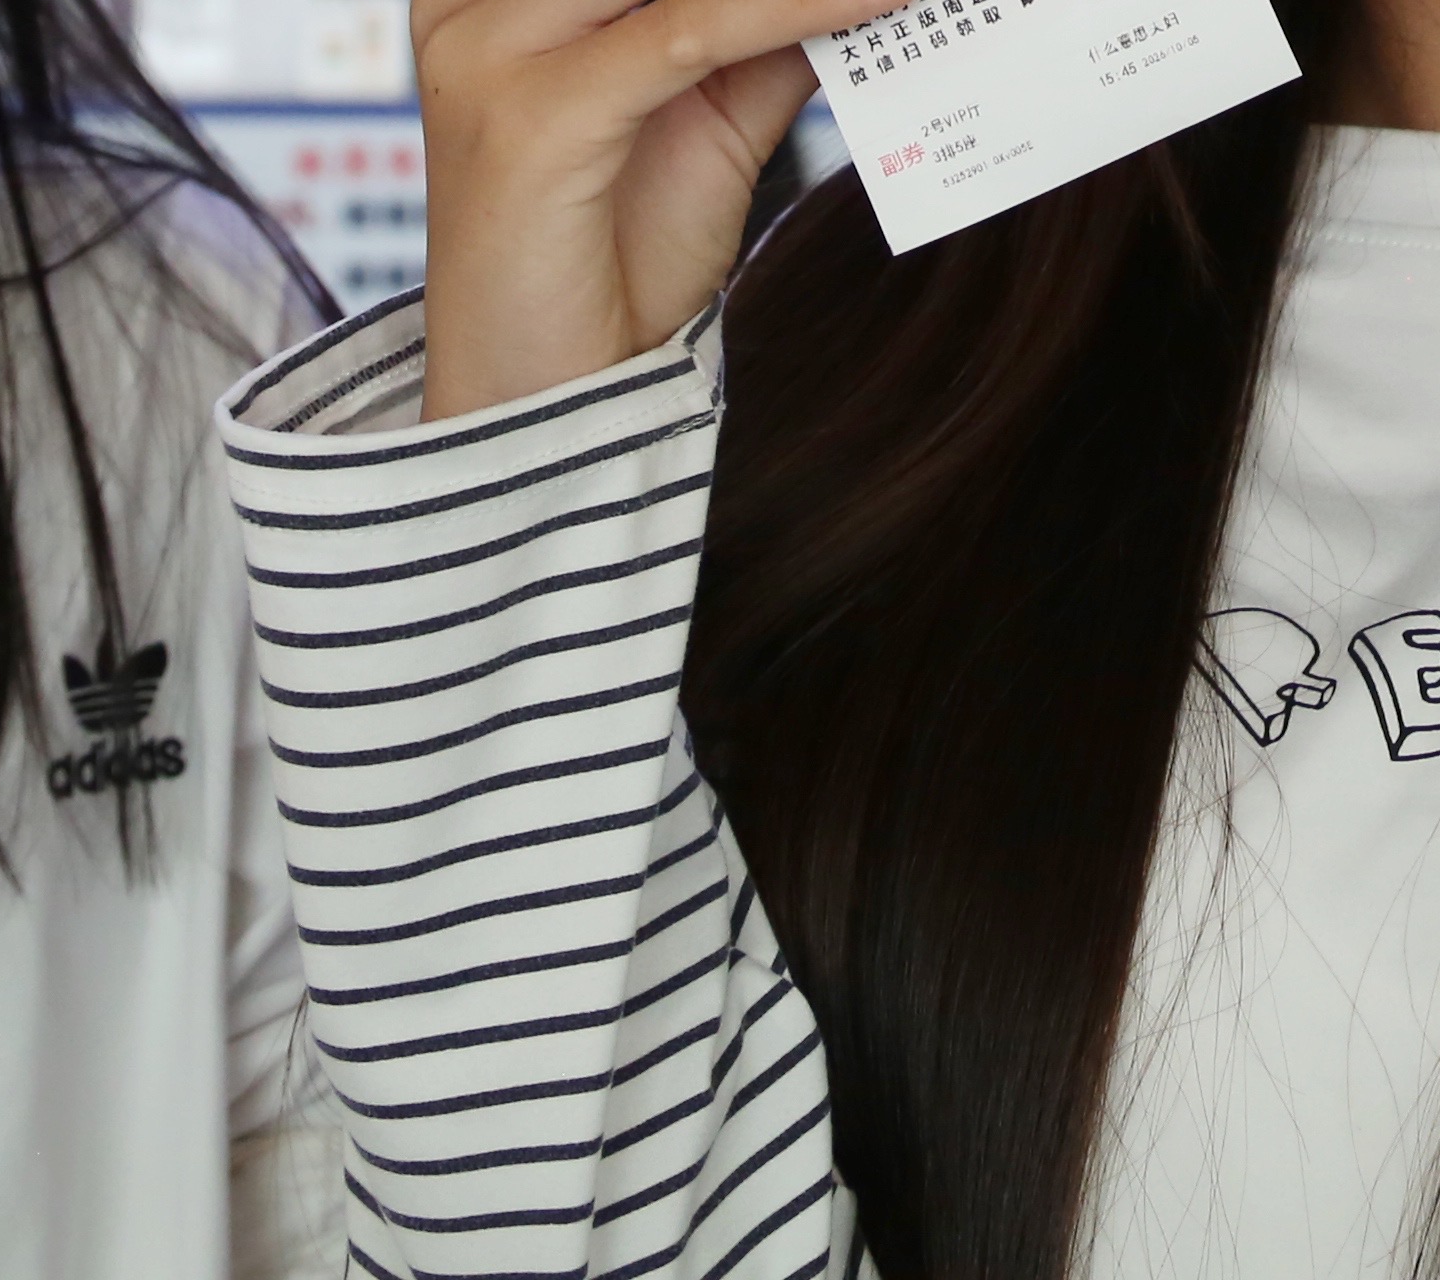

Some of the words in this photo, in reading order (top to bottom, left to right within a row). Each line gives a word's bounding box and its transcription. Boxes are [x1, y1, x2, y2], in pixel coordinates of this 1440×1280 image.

[848, 5, 1002, 87] 微信扫码领取
[1099, 61, 1137, 88] 15:45
[1141, 34, 1200, 68] 2026/10/05
[921, 104, 981, 137] 2号VIP厅
[877, 141, 926, 177] 副券
[932, 134, 977, 163] 3排5座
